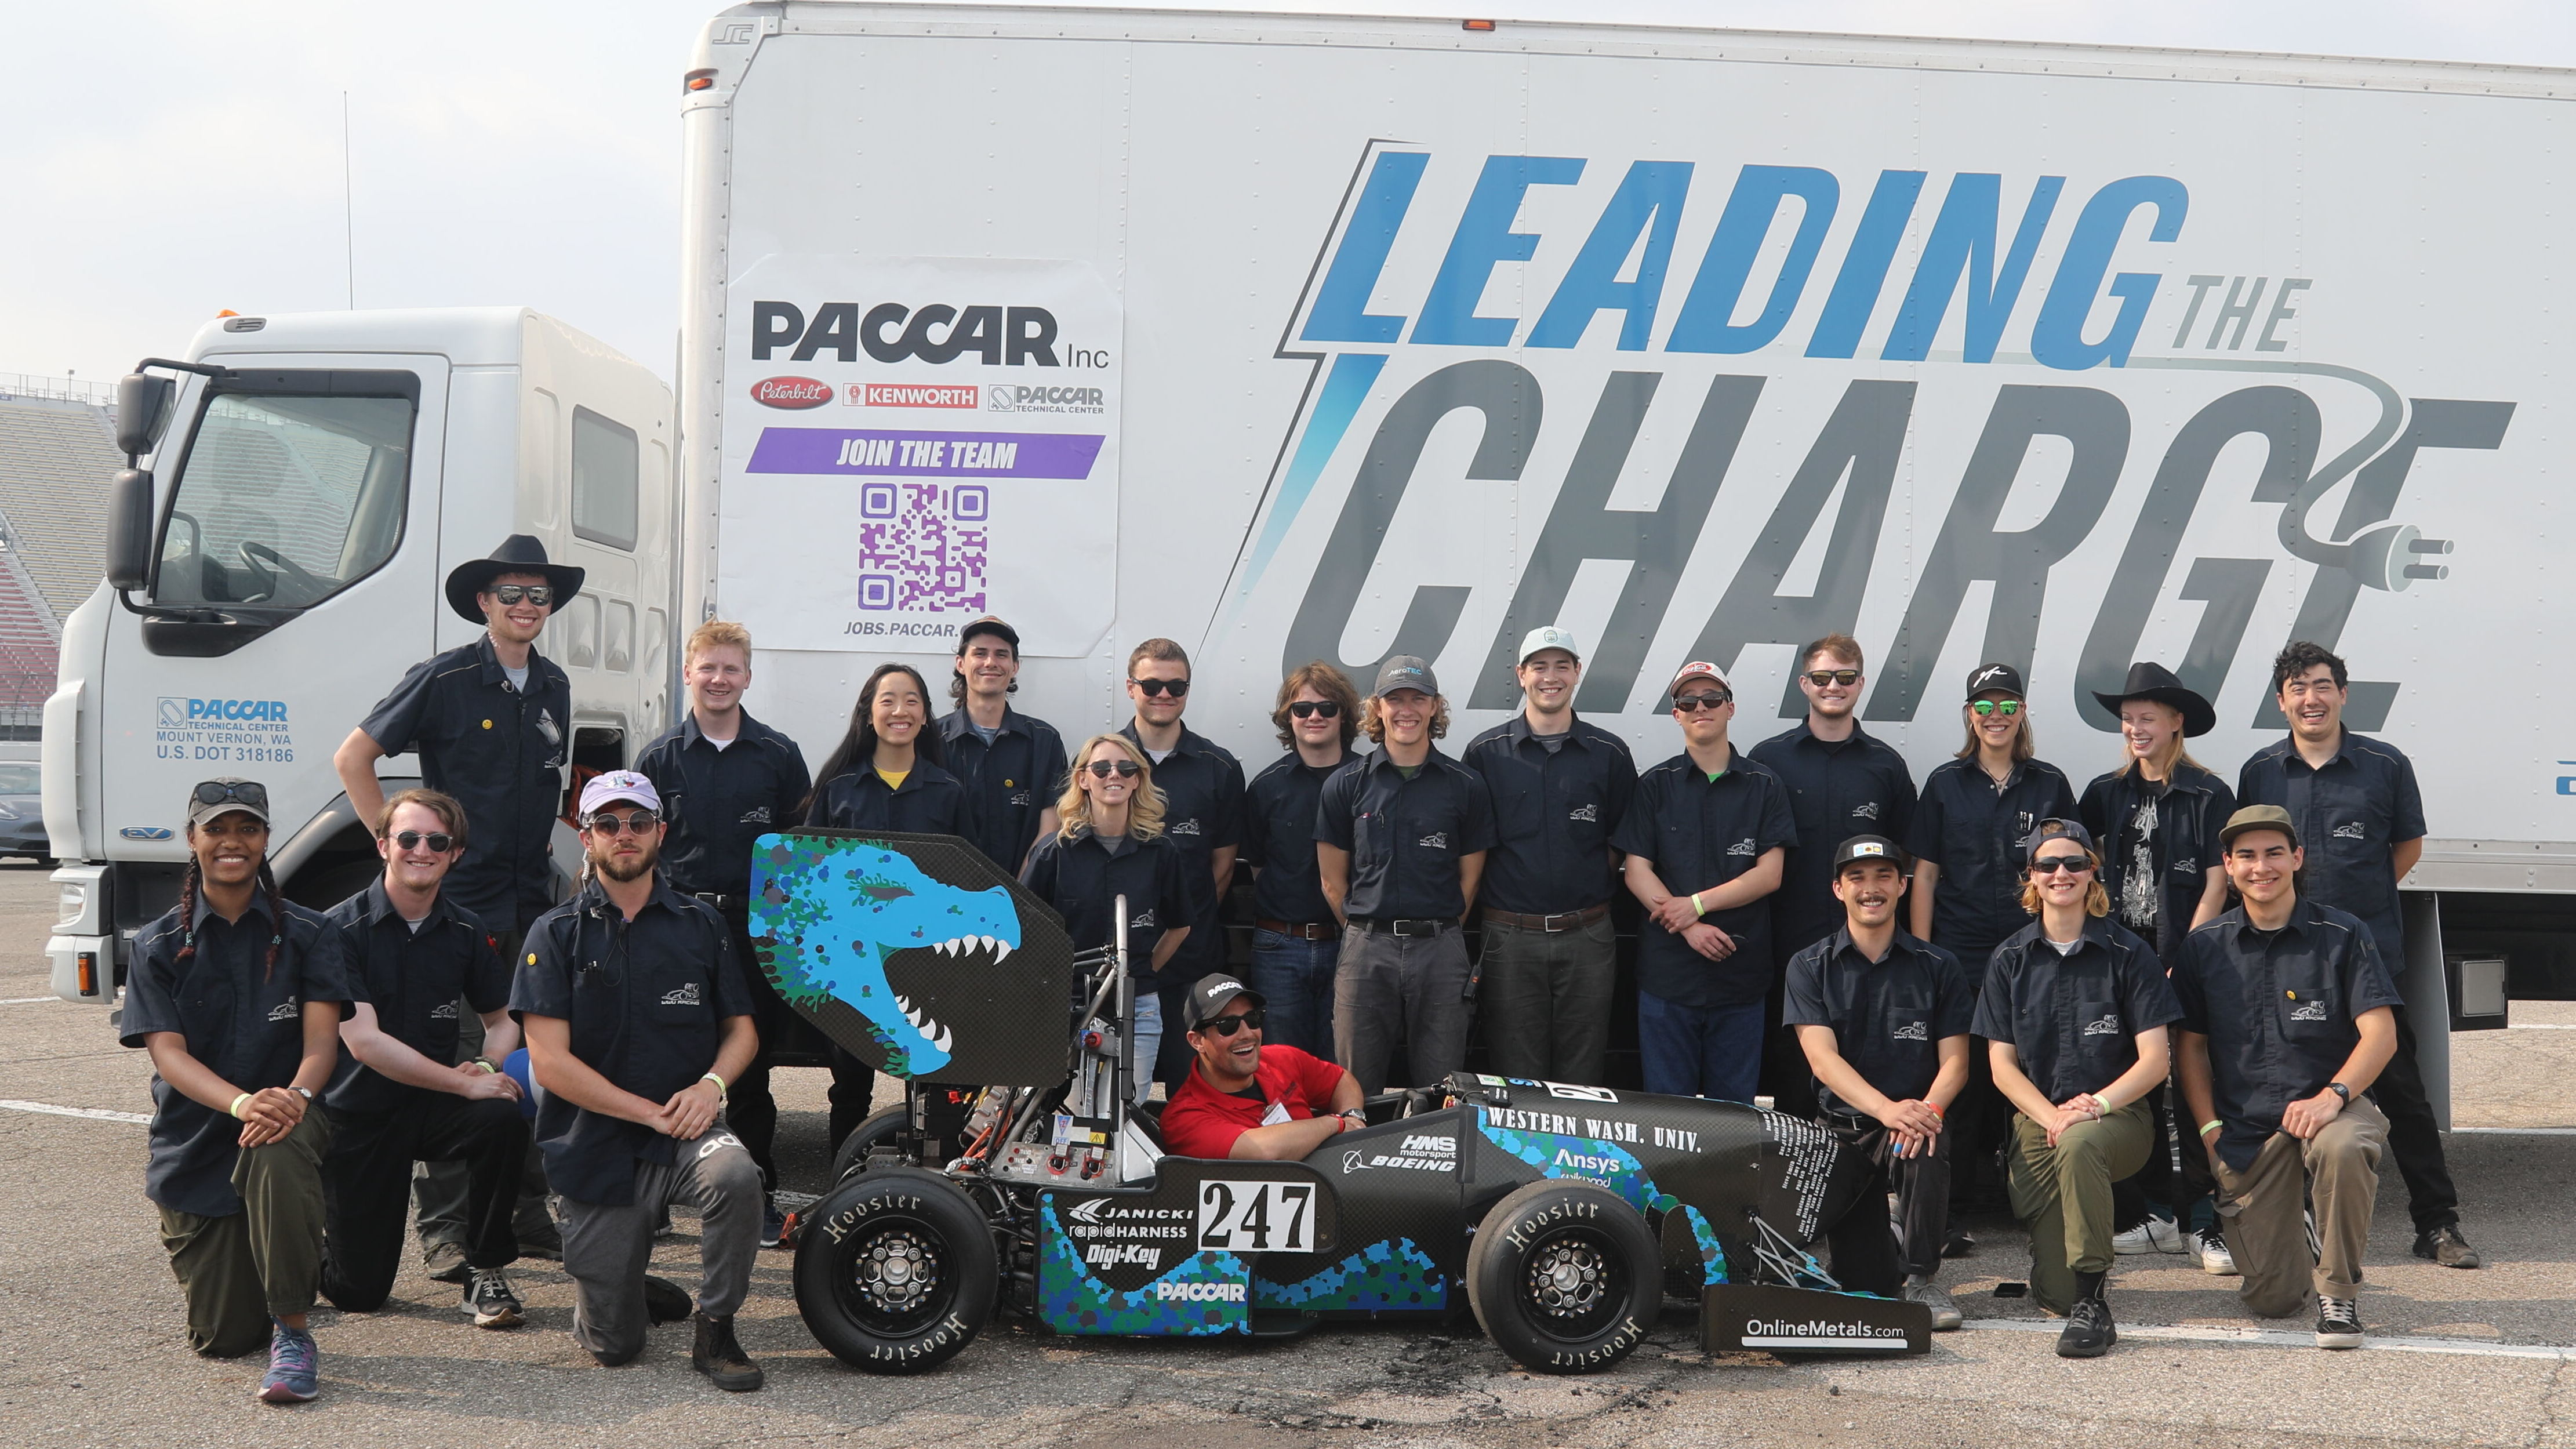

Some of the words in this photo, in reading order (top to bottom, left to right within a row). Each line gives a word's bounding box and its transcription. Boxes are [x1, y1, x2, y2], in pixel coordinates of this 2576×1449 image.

[1300, 150, 2189, 370] LEADING
[2172, 274, 2313, 353] THE
[751, 300, 1060, 366] PACCAR
[1067, 343, 1109, 369] Inc
[760, 381, 826, 400] Peterbilt
[869, 387, 974, 405] KENWORTH
[1016, 386, 1104, 405] PACCAR
[1016, 405, 1066, 413] TECHNICAL
[836, 439, 895, 466] JOIN
[899, 440, 946, 467] THE
[950, 442, 1018, 469] TEAM
[1281, 359, 2517, 732] CHARGE
[188, 699, 288, 722] PACCAR
[188, 721, 244, 731] TECHNICAL
[248, 723, 288, 732] CENTER
[157, 731, 202, 743] MOUNT
[208, 732, 266, 746] VERNON,
[271, 735, 292, 745] WA
[157, 745, 189, 759] U.S.
[195, 746, 230, 760] DOT
[236, 747, 293, 762] 318186
[127, 828, 165, 838] EV
[1207, 981, 1244, 998] PACCAR
[1488, 1106, 1577, 1136] WESTERN
[1585, 1118, 1644, 1144] WASH.
[1654, 1127, 1702, 1154] UNIV.
[1400, 1135, 1456, 1152] HMS
[1370, 1155, 1456, 1172] BOEING
[1400, 1149, 1456, 1159] motorsport
[1554, 1149, 1620, 1175] Ansys
[822, 1188, 921, 1245] Hoosier
[1105, 1207, 1194, 1220] JANICKI
[1201, 1183, 1311, 1249] 247
[1506, 1197, 1598, 1252] Hoosier
[1086, 1244, 1161, 1270] Digi-Key
[1157, 1282, 1246, 1302] PACCAR
[1746, 1319, 1904, 1337] OnlineMetals.com
[870, 1310, 968, 1367] Hoosier
[1551, 1316, 1643, 1370] Hoosier
